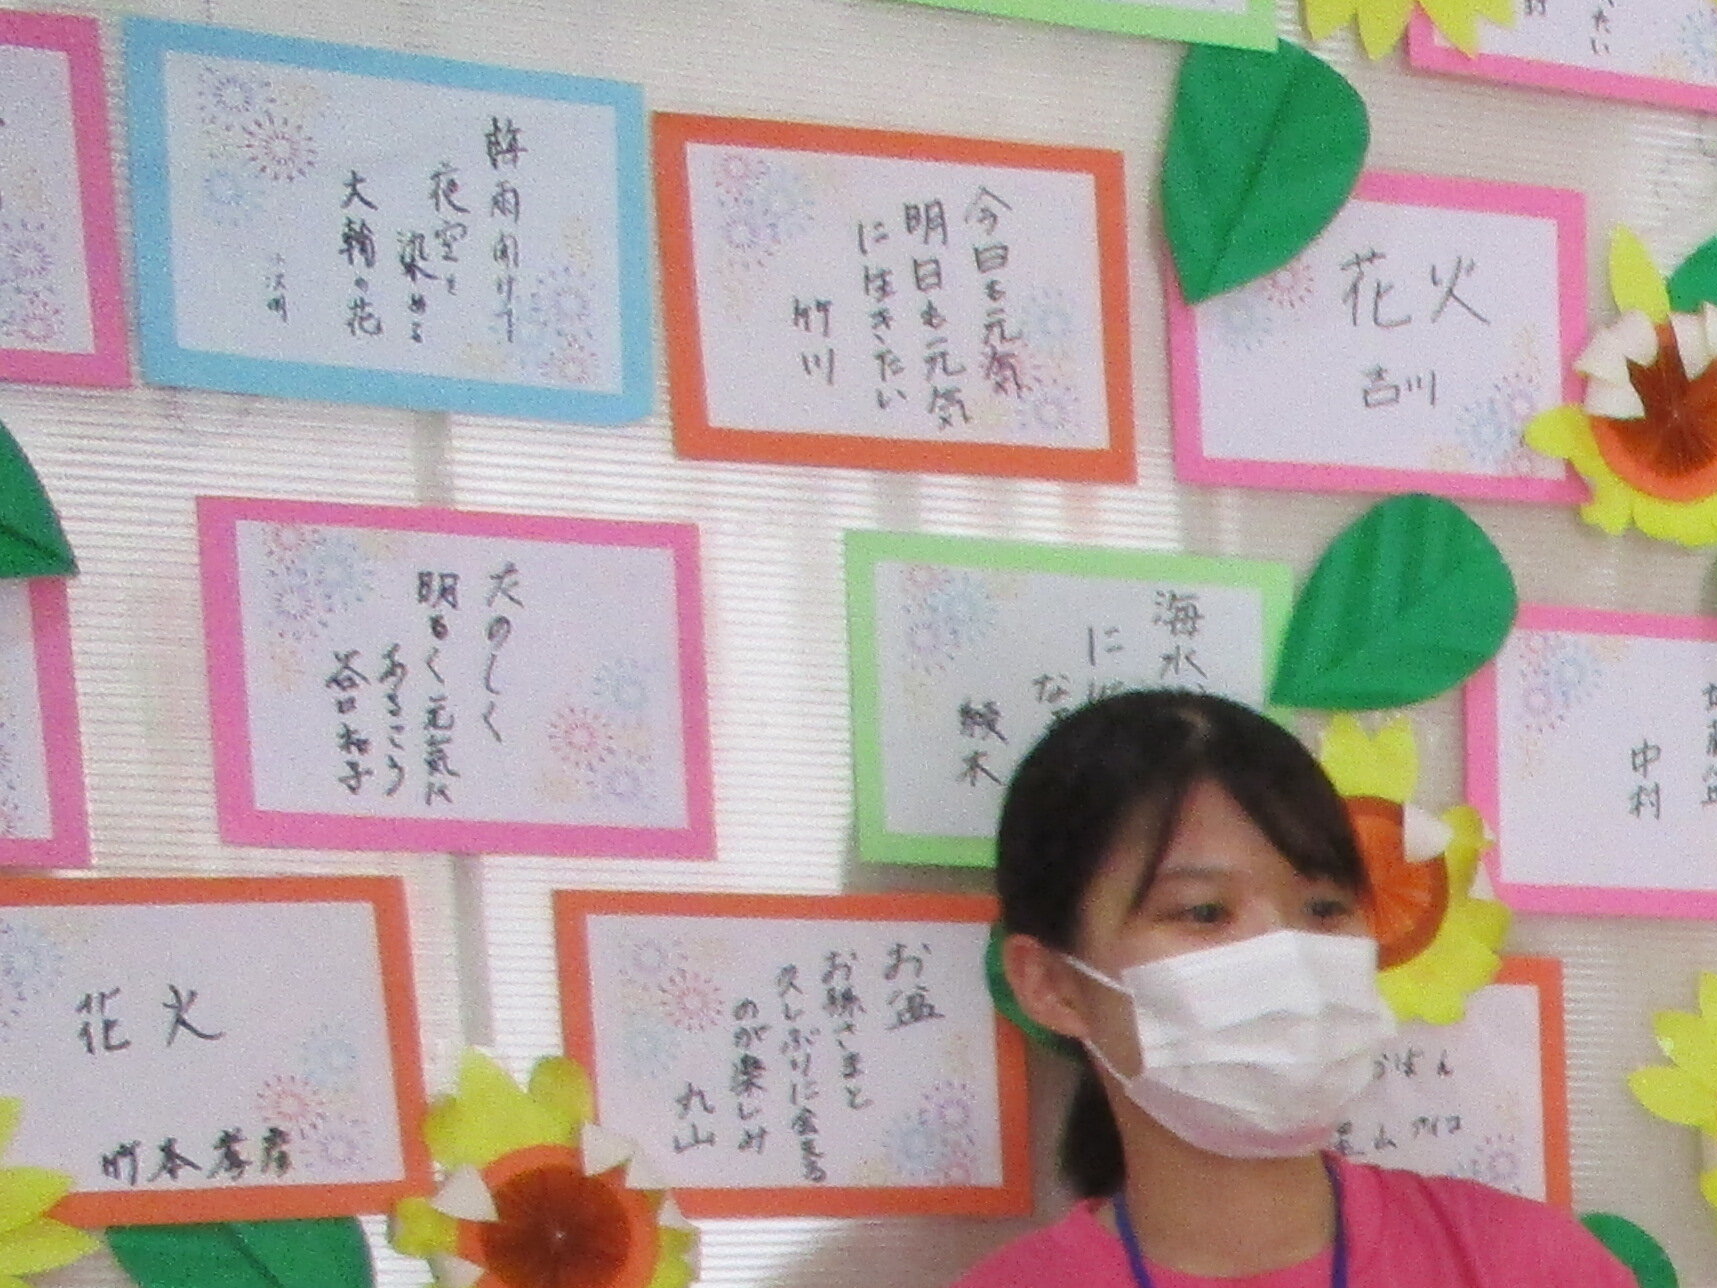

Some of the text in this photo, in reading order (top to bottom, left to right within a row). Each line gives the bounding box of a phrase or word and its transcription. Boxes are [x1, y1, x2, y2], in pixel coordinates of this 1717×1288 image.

[904, 199, 972, 430] 明日も元気
[1339, 248, 1492, 328] 花火
[1362, 363, 1437, 409] 吉川
[1628, 738, 1662, 820] 中村
[76, 983, 226, 1055] 花火
[883, 942, 945, 1031] お盆
